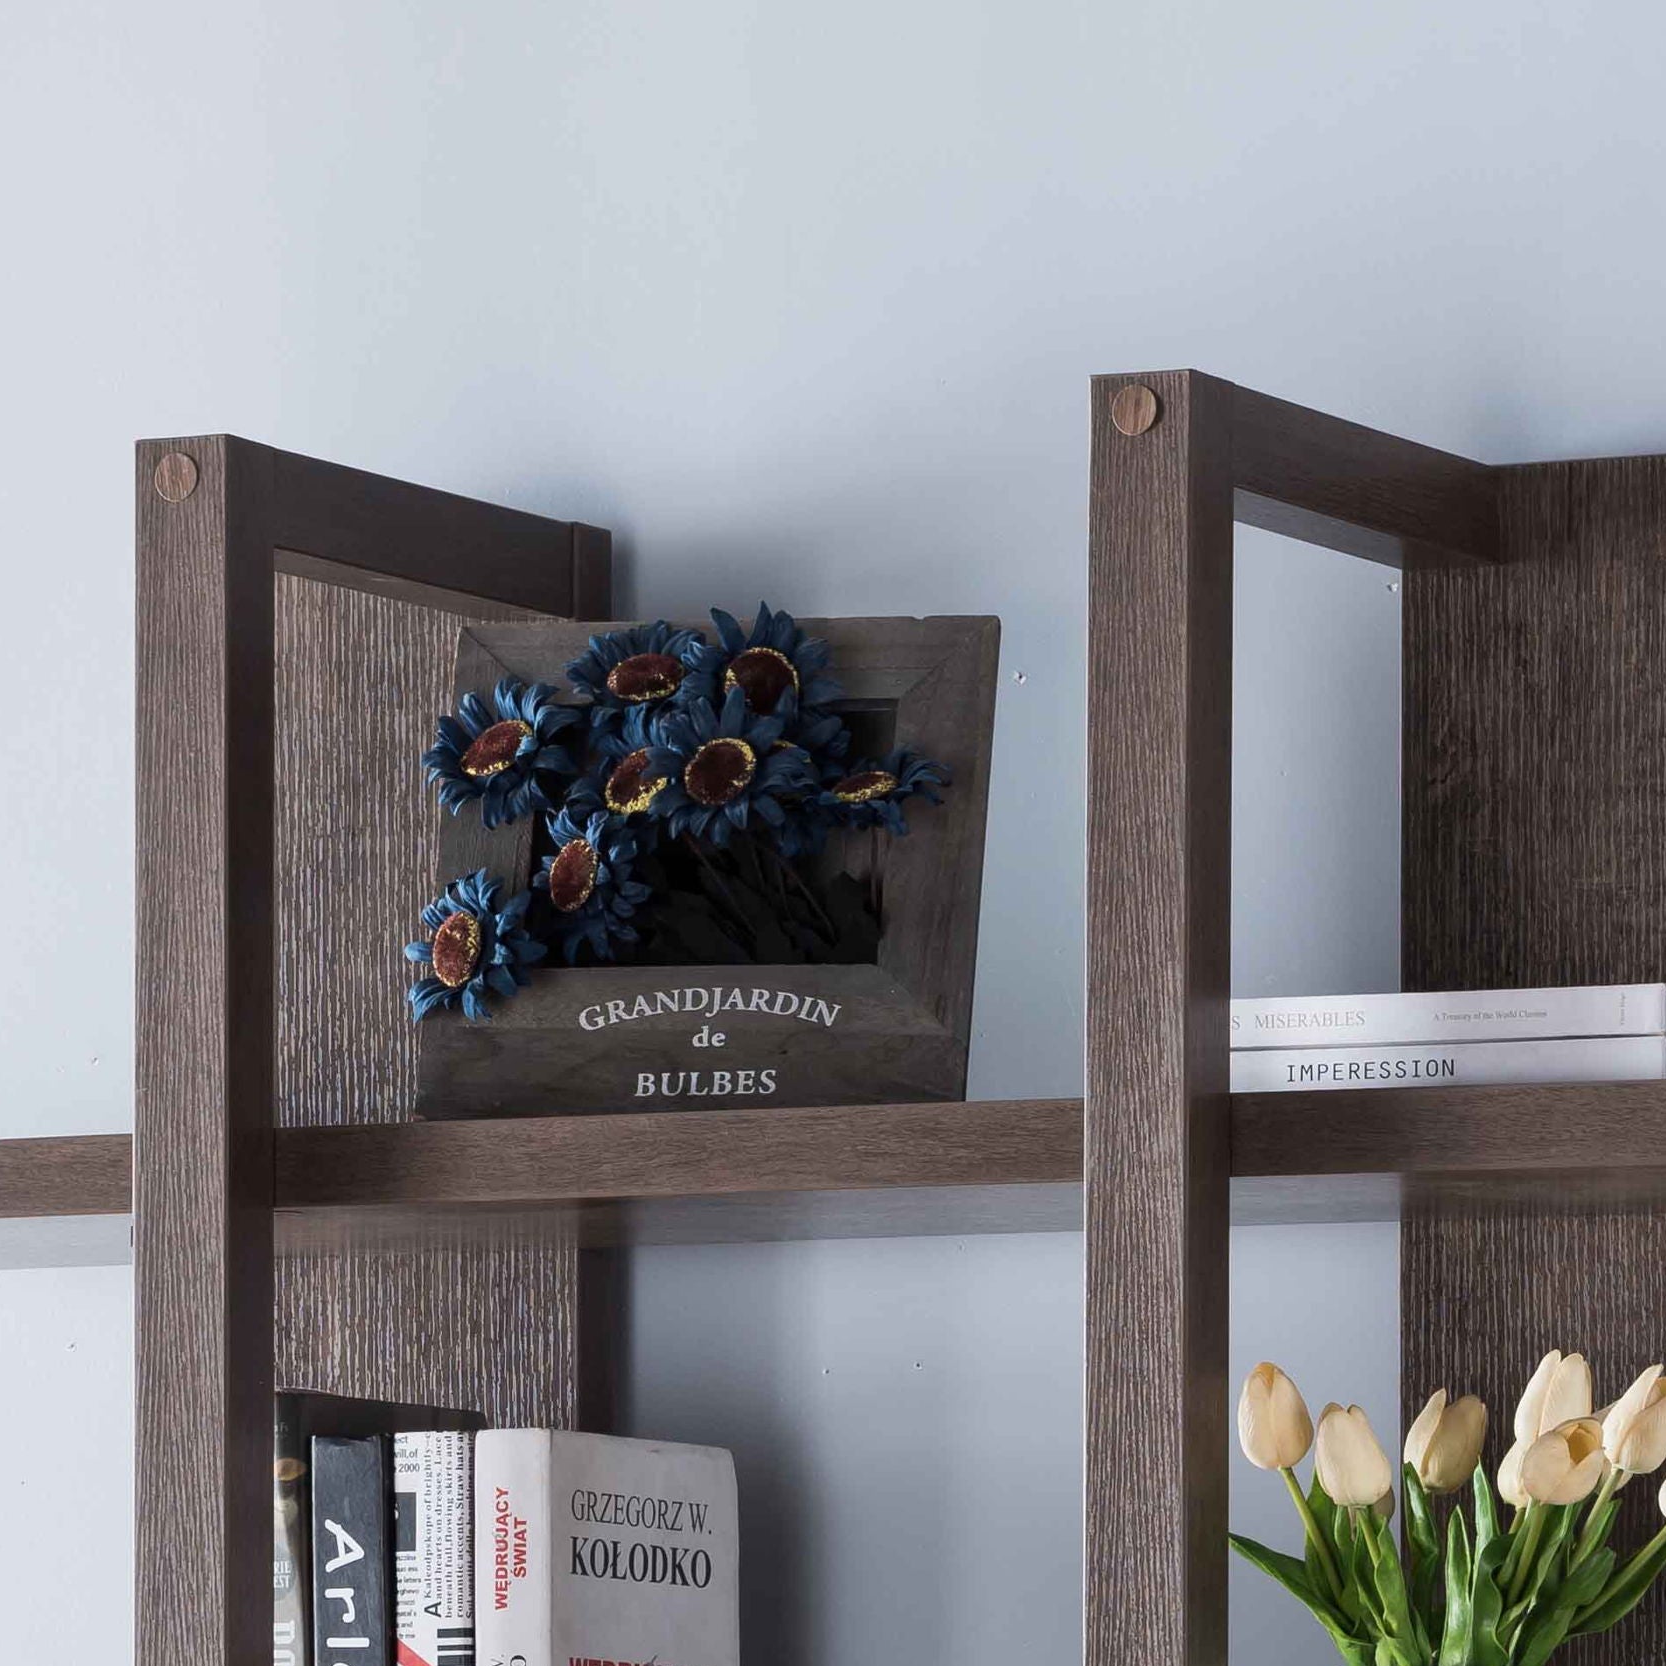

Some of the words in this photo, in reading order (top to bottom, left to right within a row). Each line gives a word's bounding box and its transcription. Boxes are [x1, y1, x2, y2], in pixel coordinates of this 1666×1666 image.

[578, 986, 842, 1031] GRANDJARDIN
[1254, 1010, 1366, 1030] MISERABLES
[692, 1025, 726, 1048] de
[634, 1069, 776, 1097] BULBES
[1286, 1058, 1455, 1083] IMPERESSION
[398, 1463, 420, 1473] 2000
[571, 1488, 684, 1532] GRZEGORZ
[687, 1502, 712, 1536] W.
[494, 1487, 512, 1610] WĘDRUJĄCY
[511, 1517, 527, 1579] ŚWIAT
[569, 1535, 712, 1589] KOŁODKO
